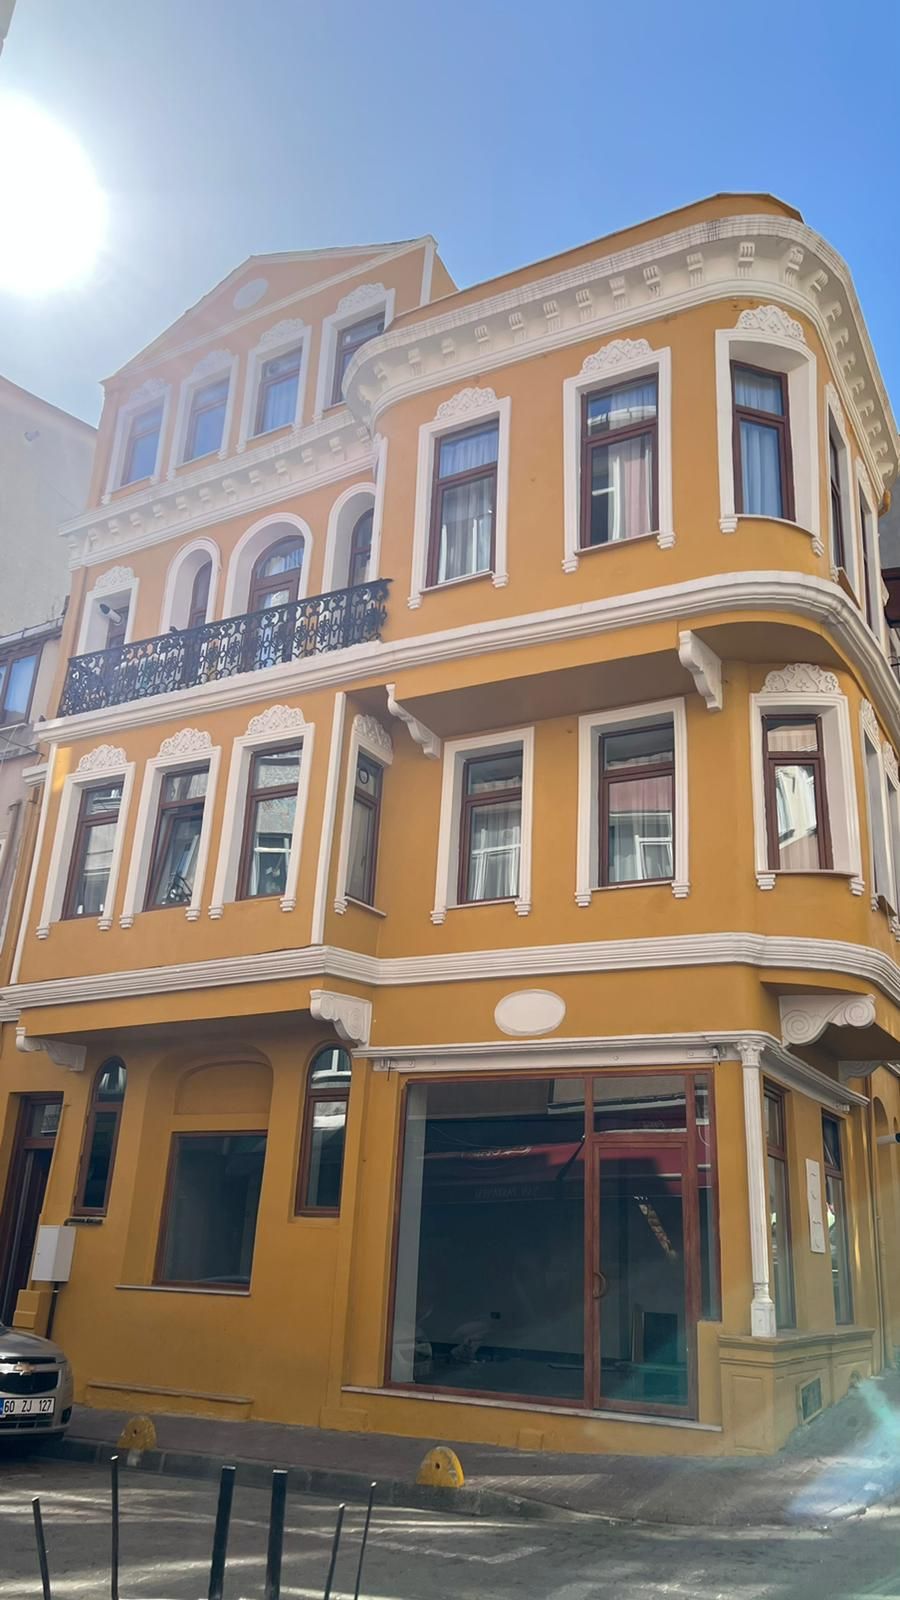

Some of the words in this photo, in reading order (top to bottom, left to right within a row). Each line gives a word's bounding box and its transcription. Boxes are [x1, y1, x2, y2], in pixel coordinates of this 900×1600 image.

[4, 1401, 15, 1413] 60
[21, 1400, 32, 1412] ZJ
[39, 1400, 52, 1411] 127
